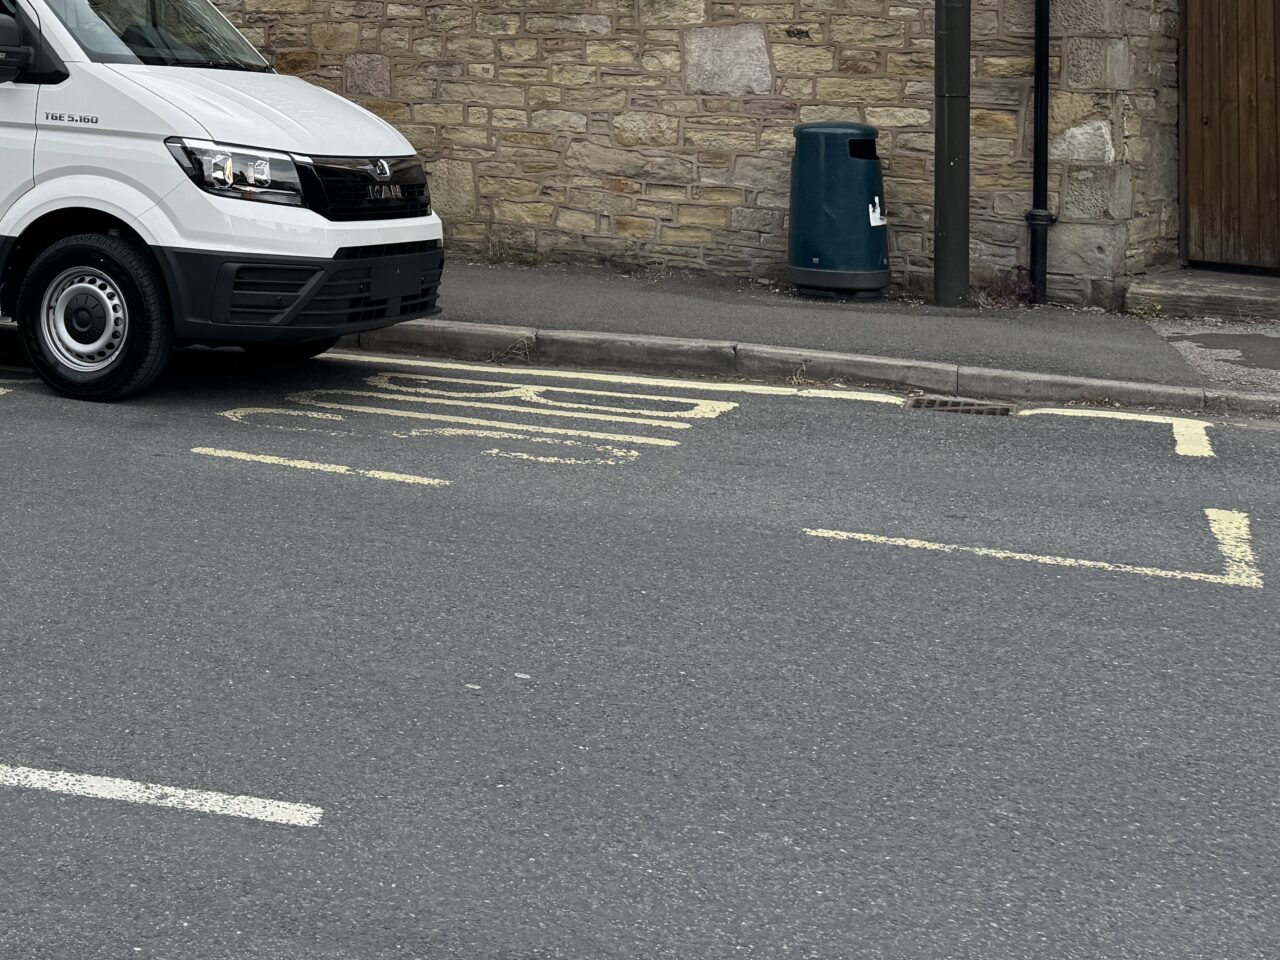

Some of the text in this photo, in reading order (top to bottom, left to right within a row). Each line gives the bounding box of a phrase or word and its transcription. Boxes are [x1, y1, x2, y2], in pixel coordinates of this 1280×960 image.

[44, 111, 99, 124] TGE 5.160
[367, 183, 403, 200] MAN
